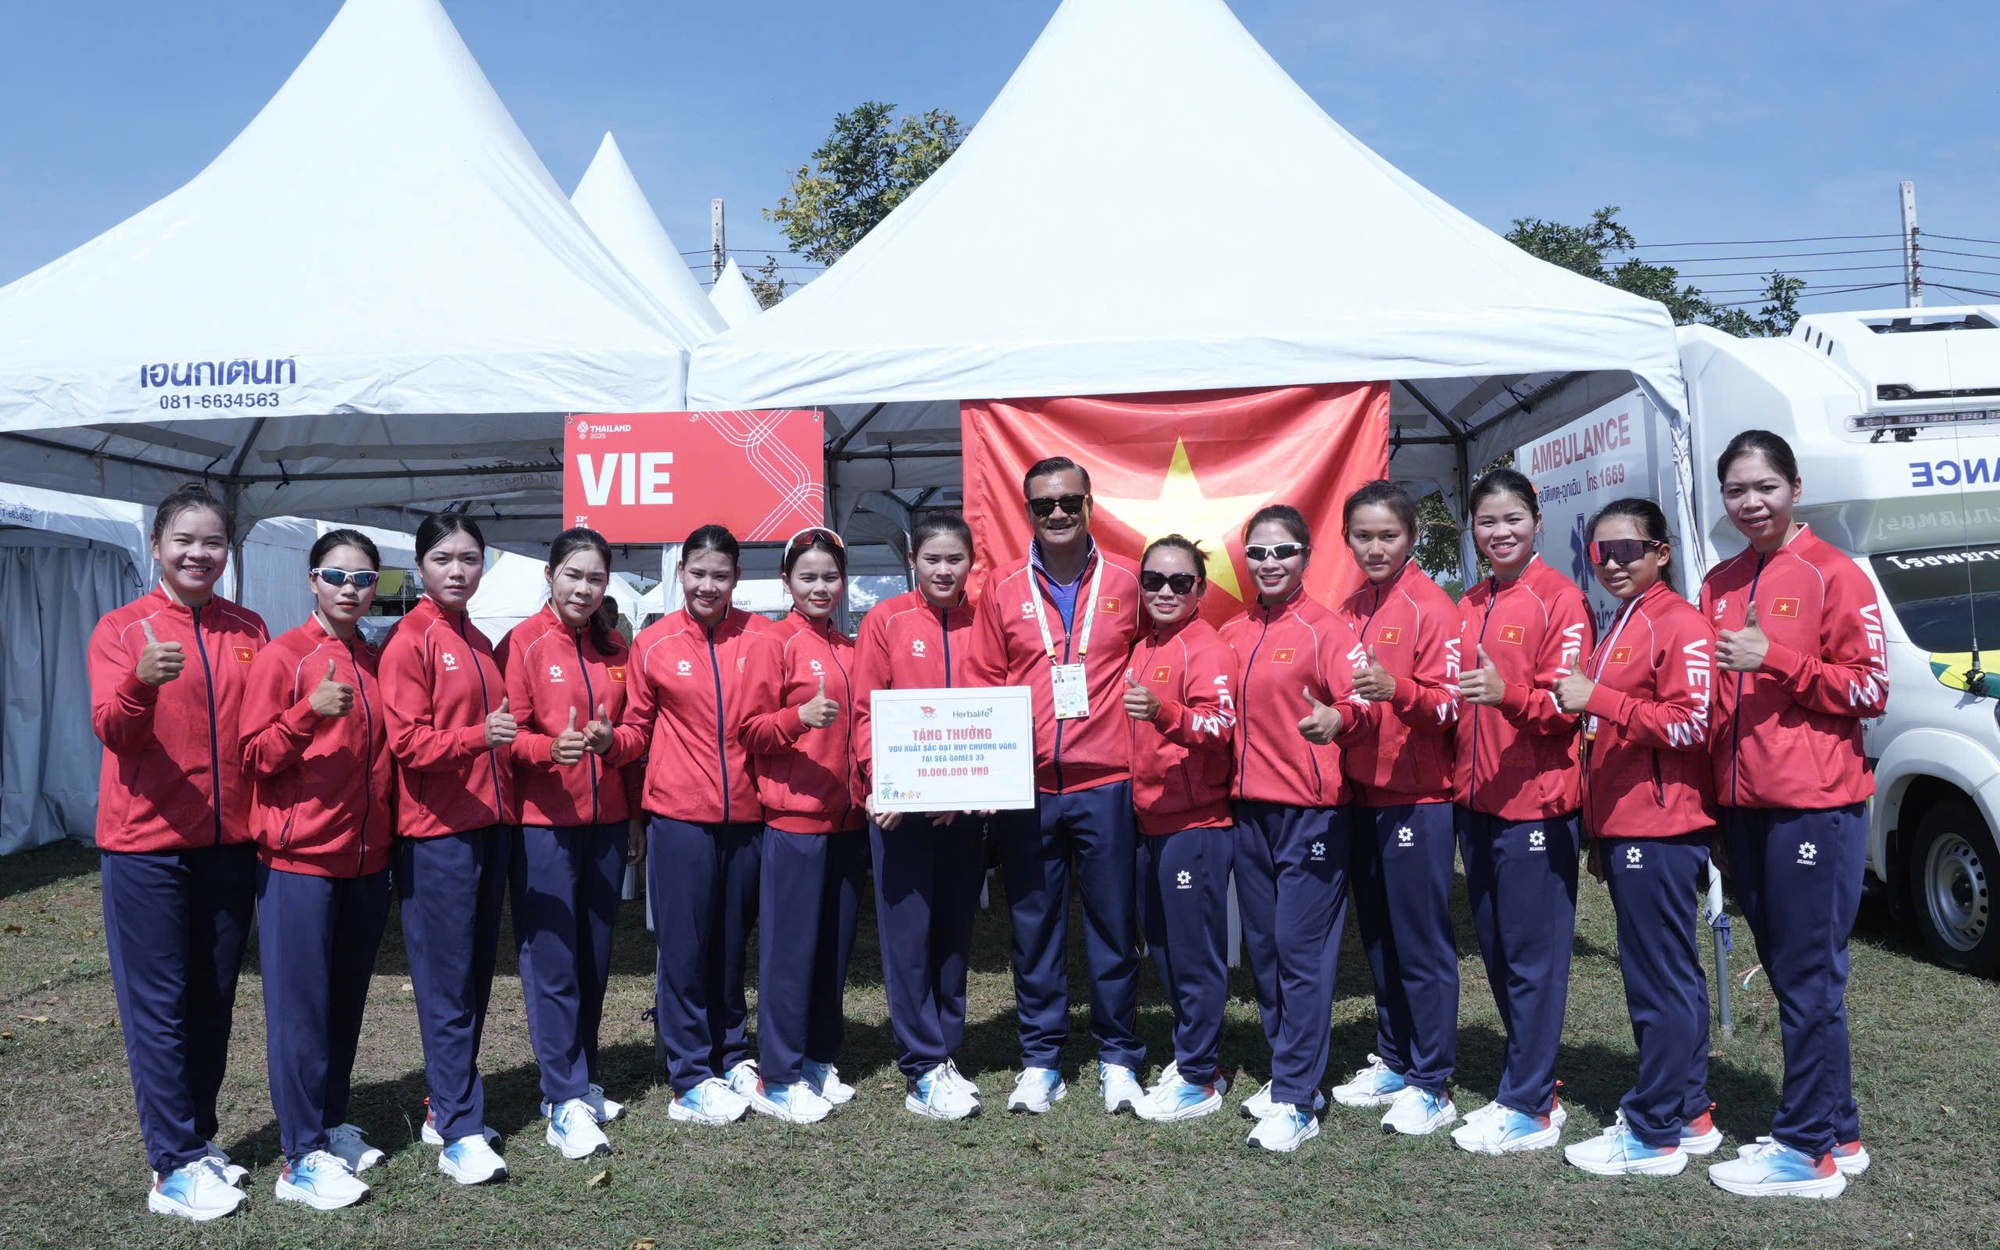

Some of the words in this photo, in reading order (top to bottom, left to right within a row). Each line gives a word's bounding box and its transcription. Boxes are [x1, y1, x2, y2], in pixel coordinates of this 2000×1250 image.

[159, 392, 280, 410] 081-6634563
[590, 425, 631, 433] THAILAND
[1531, 412, 1631, 476] AMBULANCE
[576, 452, 674, 506] VIE
[1599, 463, 1625, 488] 1669
[1886, 550, 2000, 570] โรงพยา
[952, 710, 990, 718] Herbalife
[912, 727, 942, 744] TẶNG
[947, 725, 993, 741] THƯỞNG
[954, 743, 967, 752] HUY
[934, 755, 947, 763] SEA
[949, 754, 974, 763] GAMES
[976, 754, 985, 762] 33
[917, 767, 968, 777] 10.000.000
